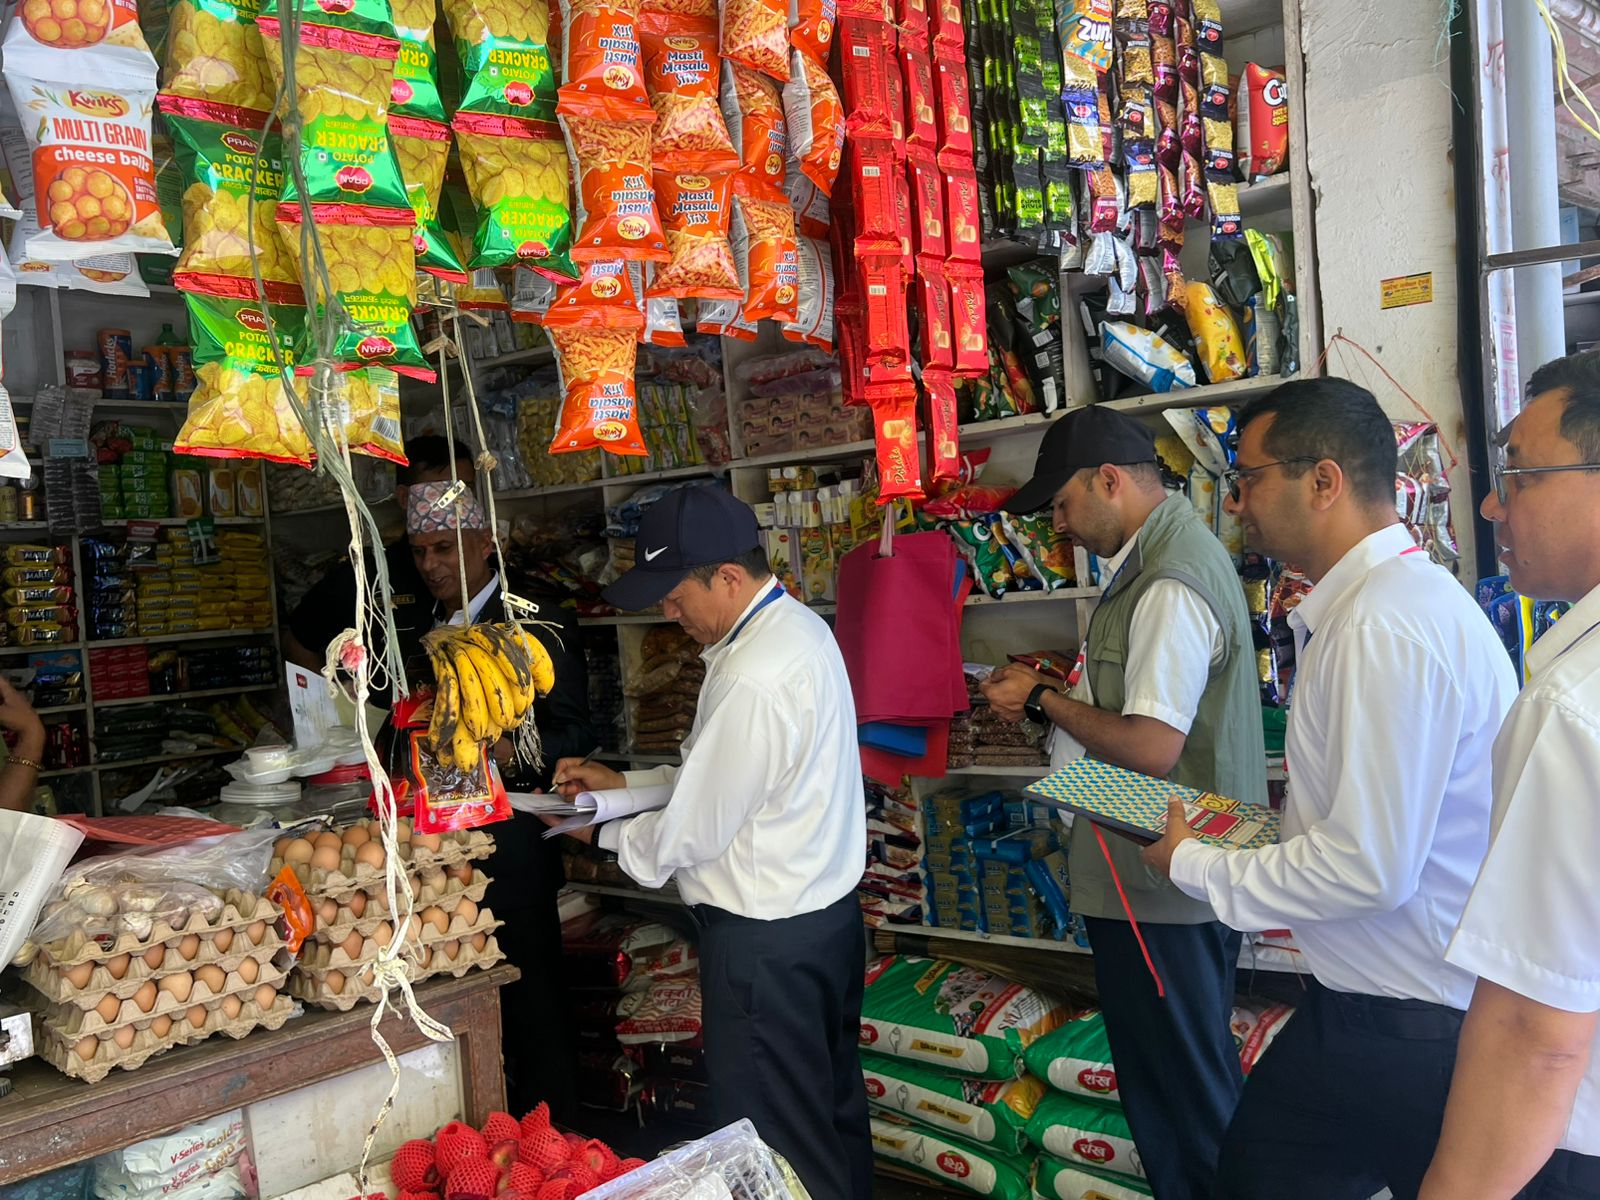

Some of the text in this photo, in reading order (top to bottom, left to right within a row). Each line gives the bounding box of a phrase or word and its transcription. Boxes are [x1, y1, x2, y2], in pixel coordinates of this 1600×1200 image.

[489, 49, 549, 71] CRACKER
[605, 52, 638, 66] Masti
[668, 50, 704, 61] Masti
[53, 117, 148, 150] MULTI GRAIN
[316, 131, 388, 153] CRACKER
[54, 147, 150, 172] cheese balls
[225, 153, 268, 168] POTAO
[333, 152, 375, 164] POTATO
[340, 174, 369, 185] PRAN
[677, 190, 714, 201] Masti
[618, 202, 651, 214] Masti
[501, 209, 563, 229] CRACKER
[592, 264, 624, 277] Masti
[594, 409, 631, 421] Masti
[170, 1123, 235, 1164] V-Series Gold
